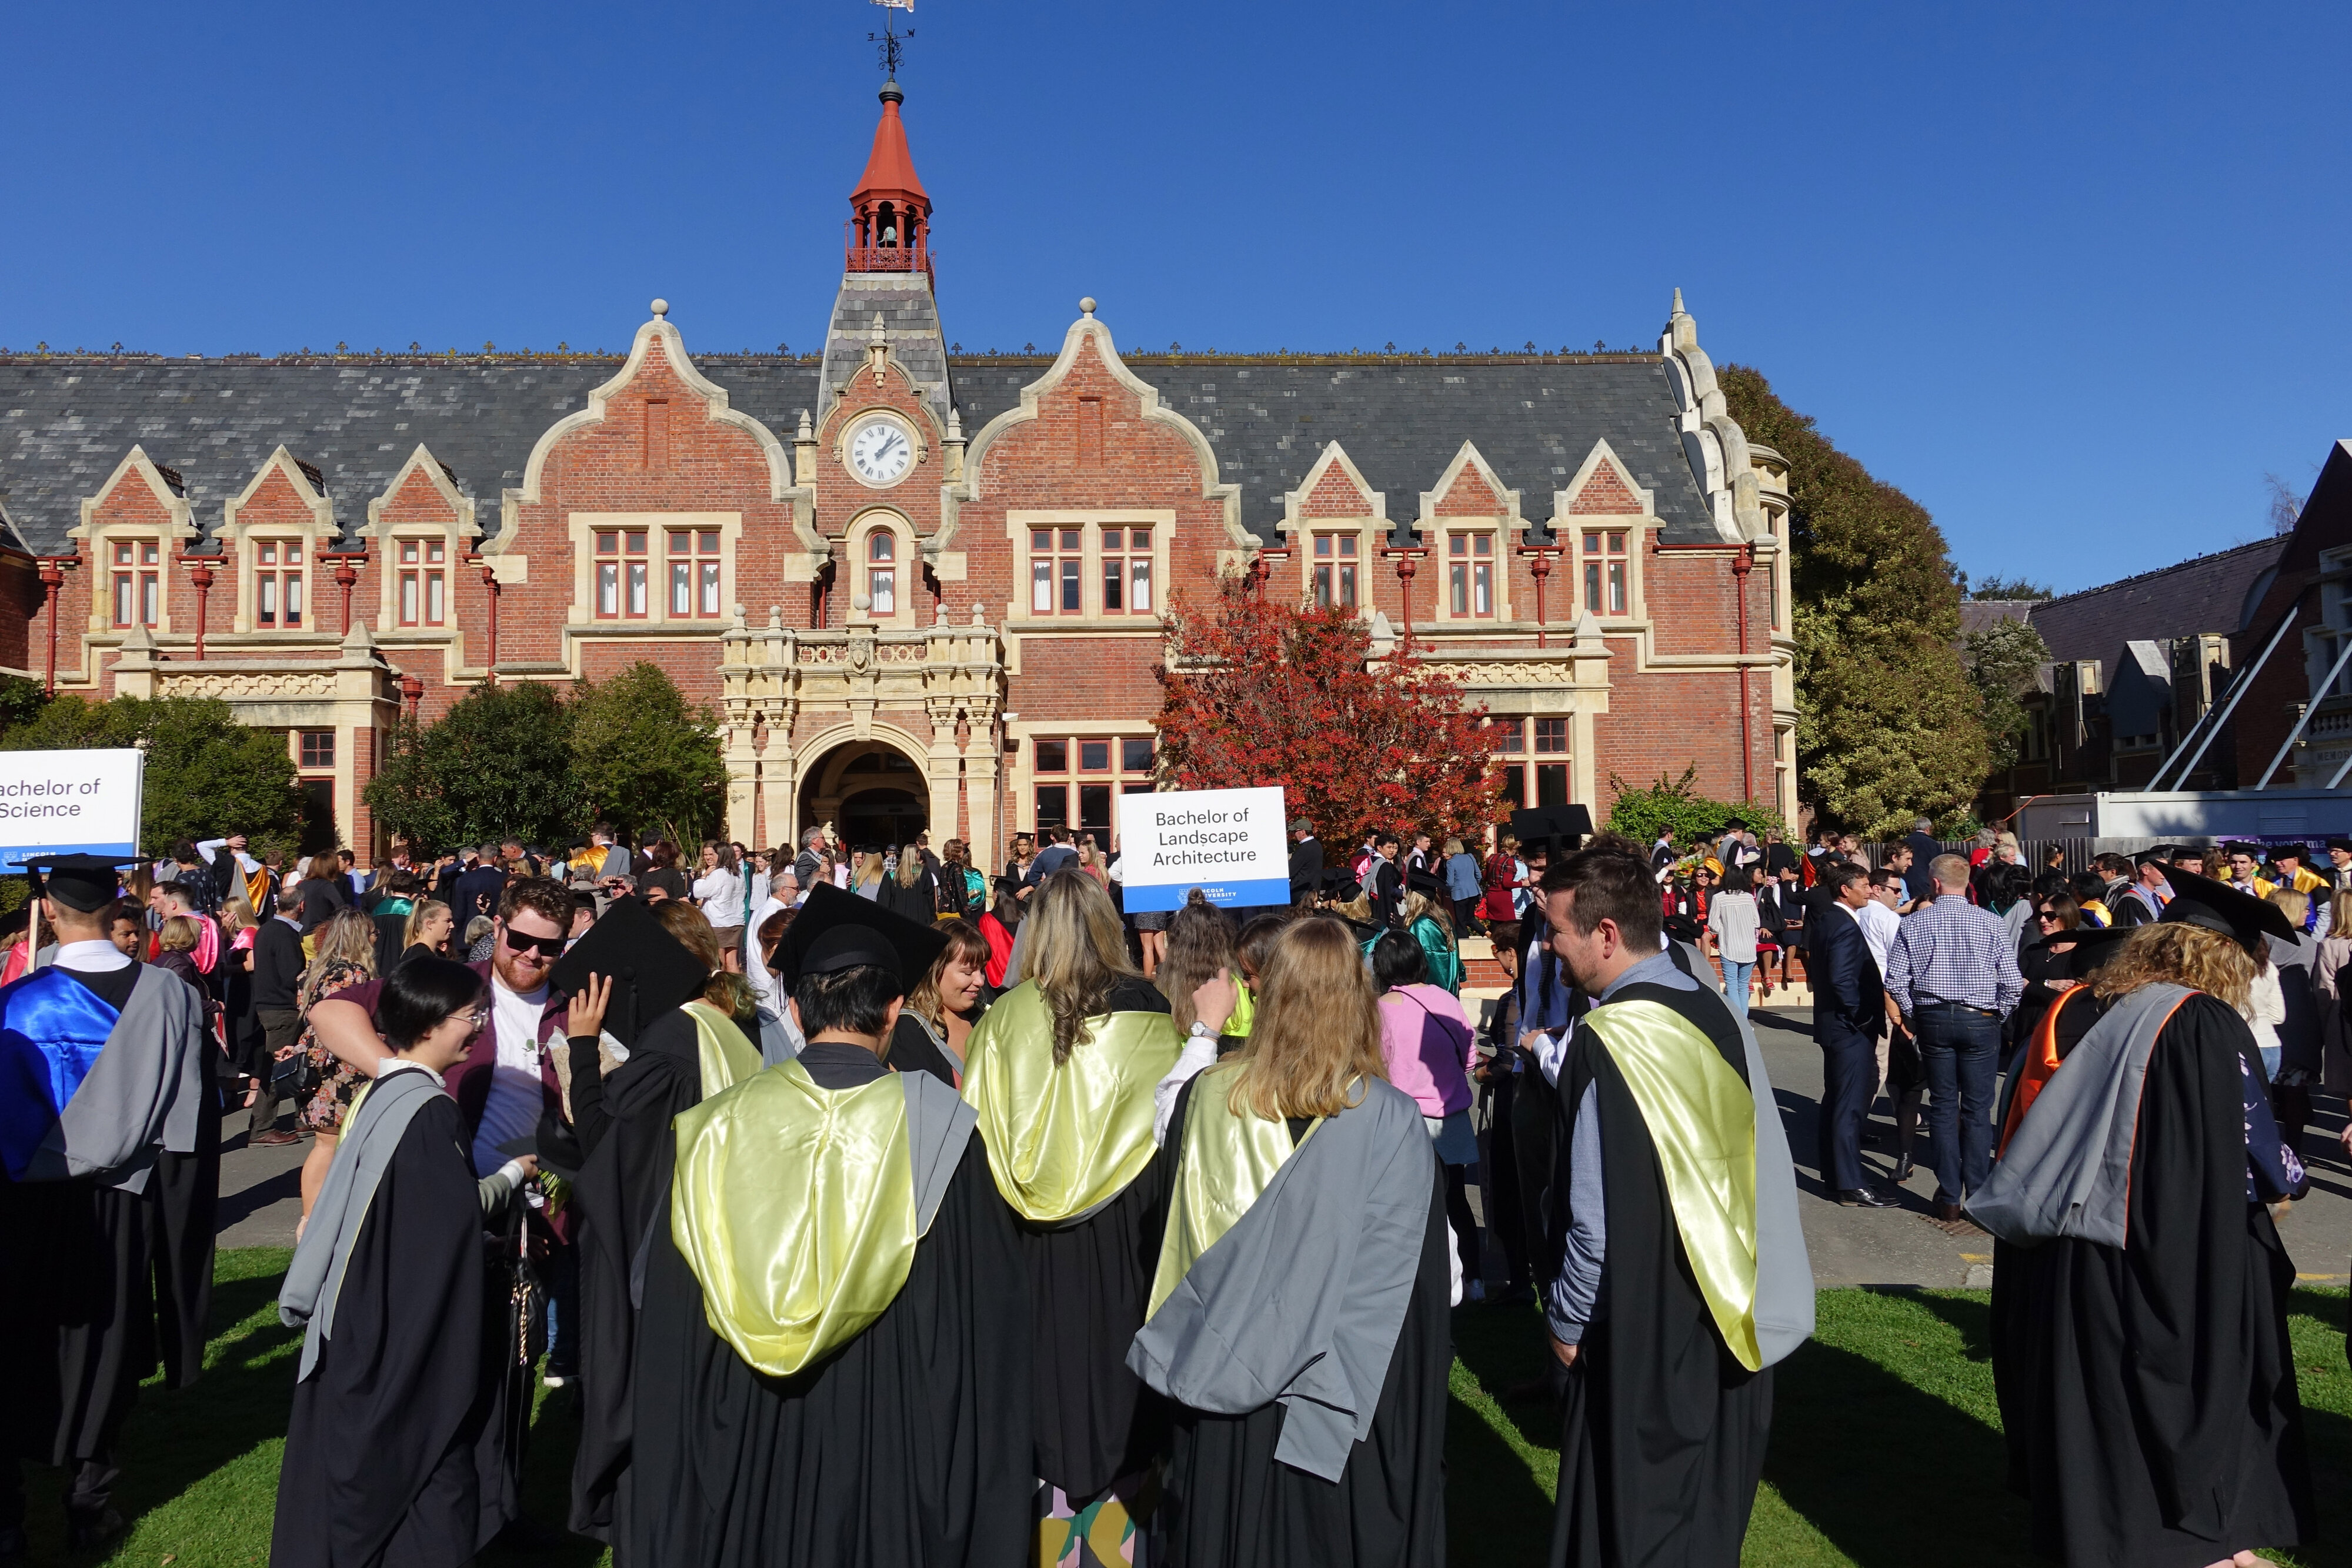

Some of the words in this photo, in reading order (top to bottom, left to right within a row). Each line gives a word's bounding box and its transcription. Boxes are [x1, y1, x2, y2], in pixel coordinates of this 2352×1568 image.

[2317, 750, 2352, 762] MEMOR
[0, 779, 74, 796] achelor
[79, 778, 101, 795] of
[0, 802, 81, 818] Science
[1156, 809, 1228, 826] Bachelor
[1233, 808, 1249, 822] of
[1159, 830, 1248, 846] Landscape
[1153, 850, 1256, 866] Architecture
